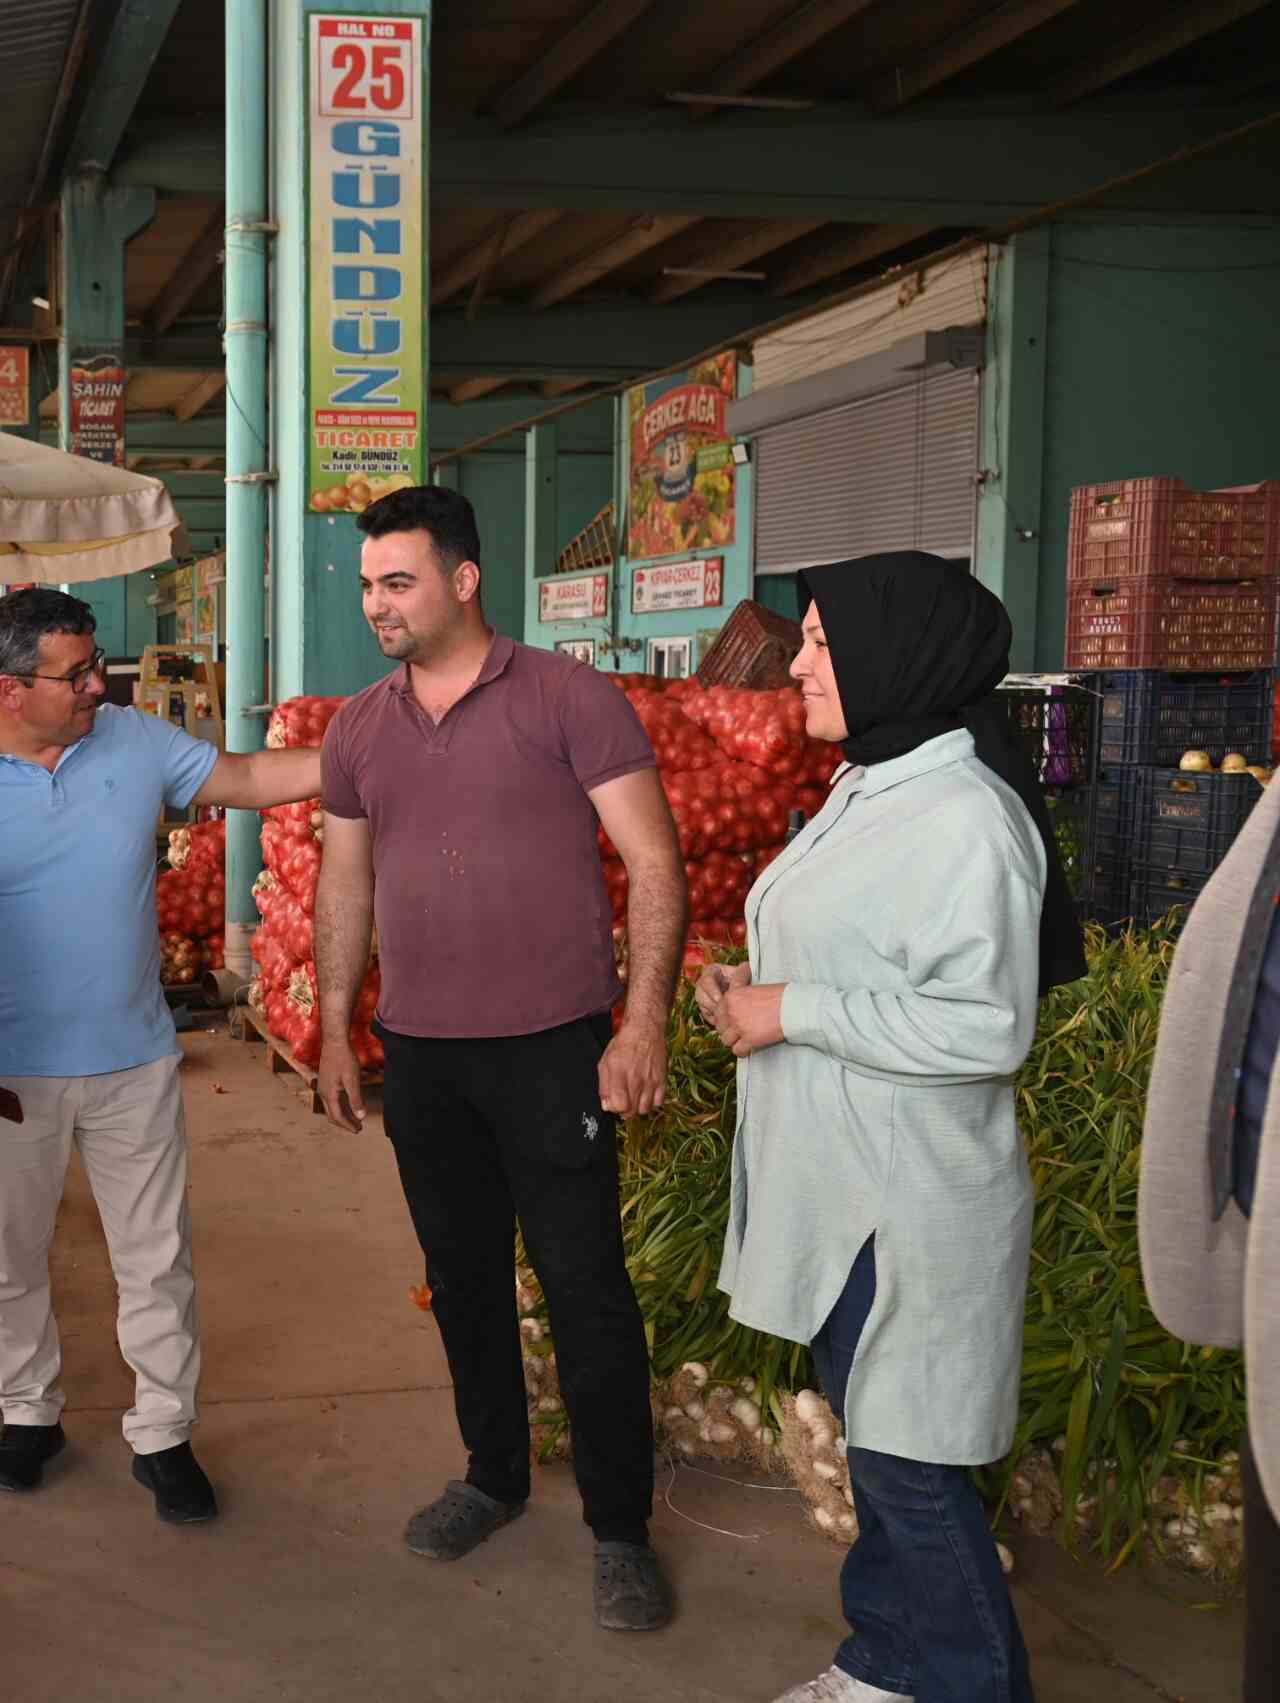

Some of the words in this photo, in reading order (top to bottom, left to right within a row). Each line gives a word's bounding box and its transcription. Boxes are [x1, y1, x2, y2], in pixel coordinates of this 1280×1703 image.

[336, 22, 367, 35] HAL
[372, 23, 395, 37] NO
[331, 43, 405, 111] 25
[331, 120, 402, 404] GÜNDÜZ
[72, 382, 123, 400] ŞAHİN
[80, 400, 116, 416] TİCARET
[705, 569, 721, 601] 23
